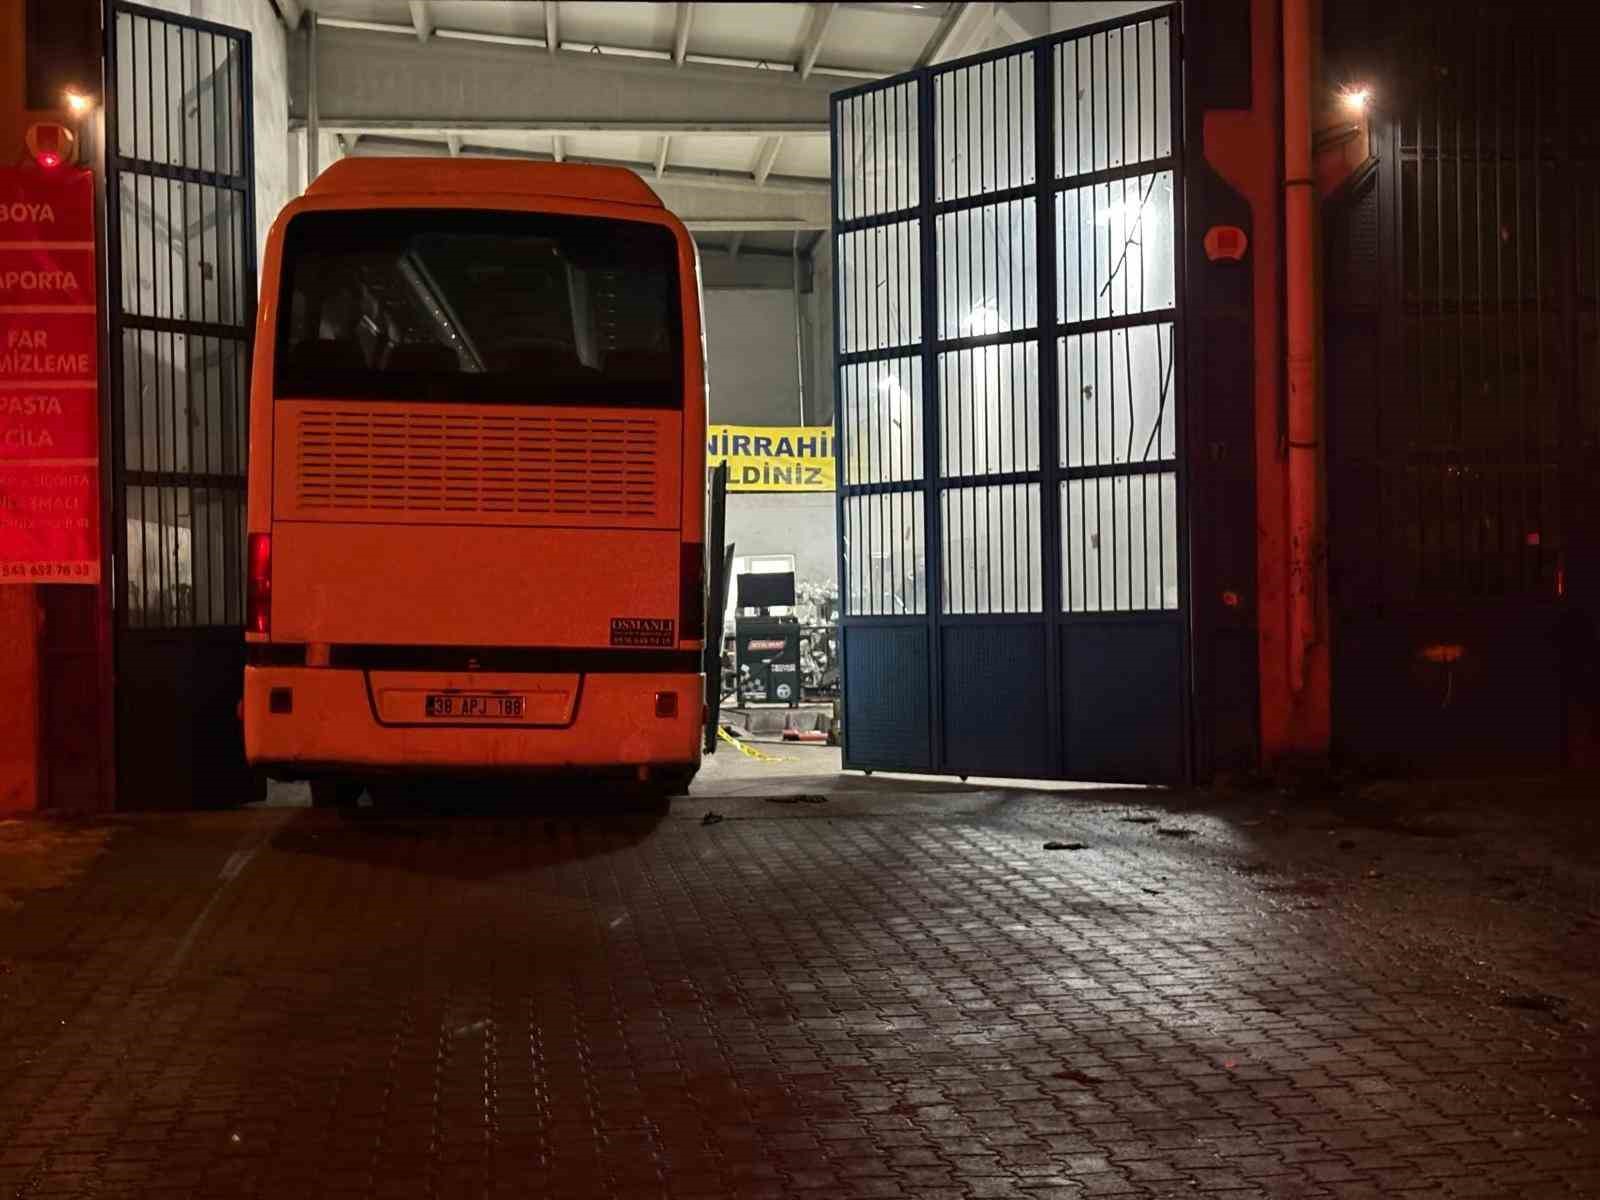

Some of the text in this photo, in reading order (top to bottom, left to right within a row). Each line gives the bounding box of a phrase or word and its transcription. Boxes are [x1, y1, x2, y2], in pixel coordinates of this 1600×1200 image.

[0, 271, 78, 289] PORTA
[8, 330, 47, 348] FAR
[708, 429, 836, 457] NİRRAHİ
[711, 461, 822, 484] LDİNİZ
[462, 697, 487, 714] APJ
